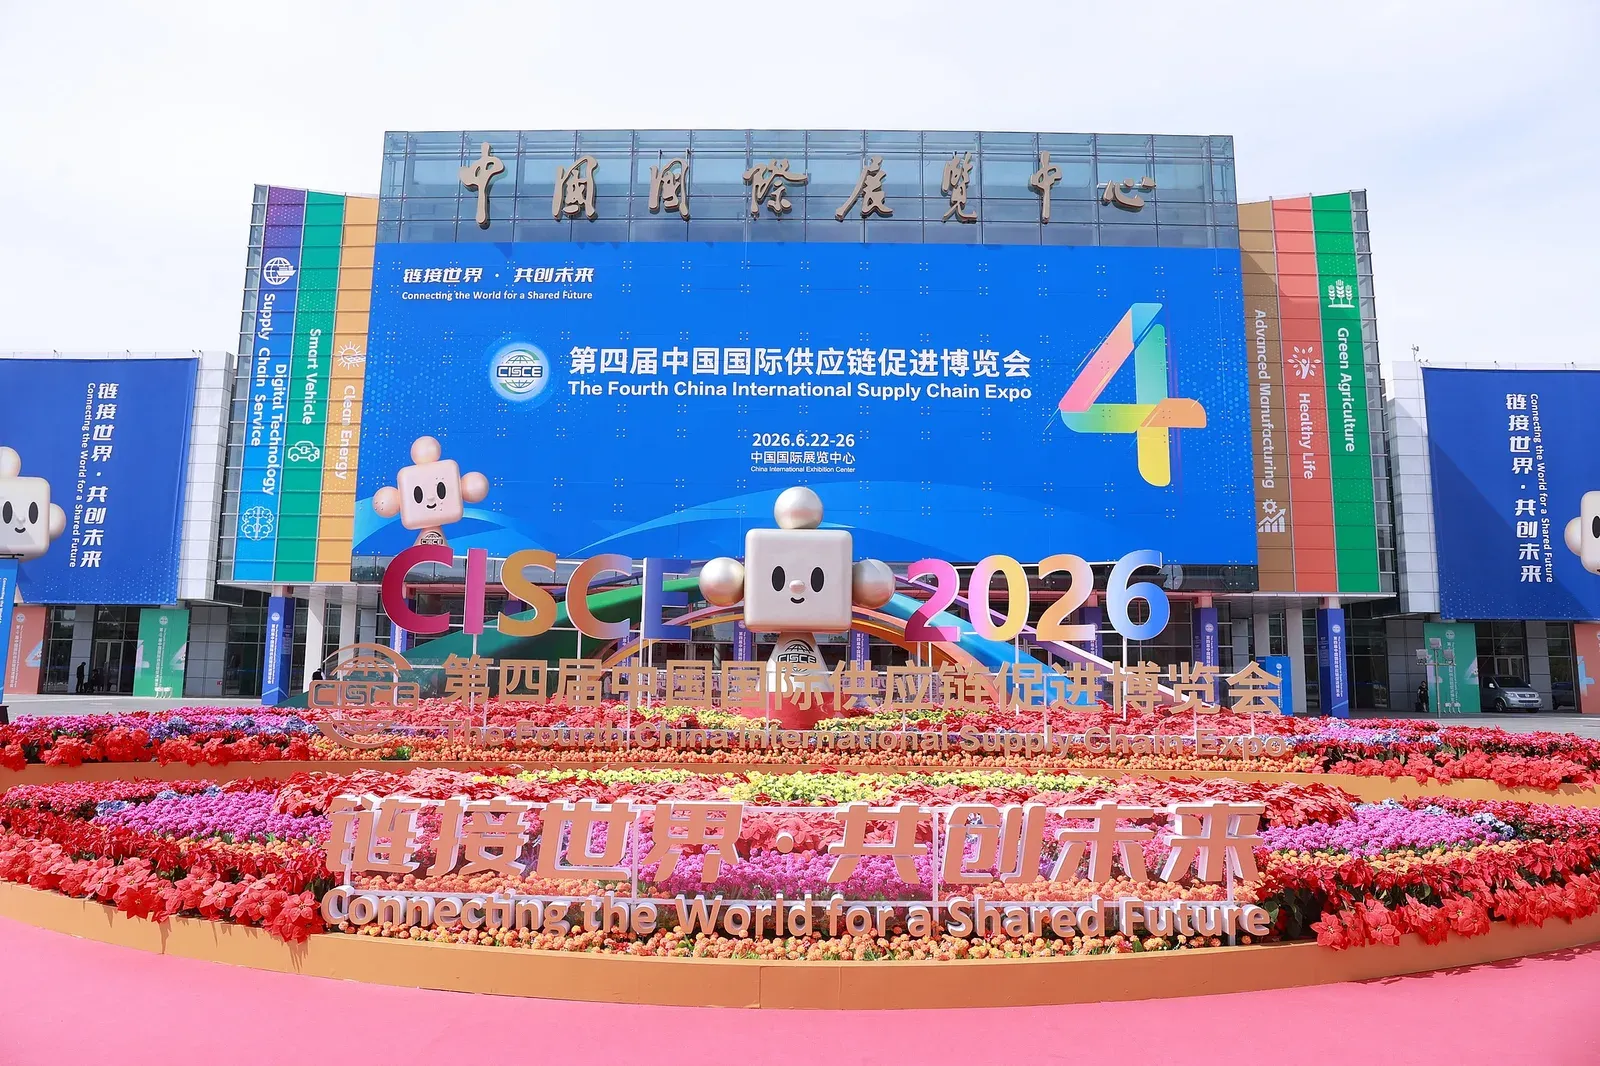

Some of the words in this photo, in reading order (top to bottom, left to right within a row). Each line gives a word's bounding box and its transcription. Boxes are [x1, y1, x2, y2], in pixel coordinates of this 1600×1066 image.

[402, 291, 452, 301] Connecting
[455, 291, 470, 300] the
[473, 291, 501, 300] World
[503, 291, 518, 300] for
[528, 291, 560, 300] Shared
[563, 291, 593, 300] Future
[258, 293, 276, 340] Supply
[307, 328, 321, 369] Smart
[569, 346, 1032, 378] 第四届中国国际供应链促进博览会
[1254, 309, 1271, 380] Advanced
[1337, 327, 1350, 369] Green
[256, 347, 271, 387] Chain
[271, 364, 287, 410] Digital
[498, 366, 542, 377] CISCE
[81, 382, 96, 431] Connecting
[302, 373, 318, 425] Vehicle
[341, 385, 356, 426] Clean
[568, 381, 603, 396] The
[608, 381, 668, 396] Fourth
[674, 381, 727, 397] China
[733, 381, 851, 397] International
[857, 383, 922, 401] Supply
[926, 383, 980, 399] Chain
[985, 384, 1032, 402] Expo
[251, 394, 266, 446] Service
[1298, 393, 1313, 449] Healthy
[1339, 373, 1356, 452] Agriculture
[1530, 393, 1542, 443] Connecting
[81, 433, 91, 448] the
[262, 414, 283, 495] Technology
[335, 430, 352, 479] Energy
[752, 433, 855, 447] 2026.6.22-26
[1259, 382, 1276, 489] Manufacturing
[1535, 445, 1544, 460] the
[78, 450, 89, 477] World
[751, 451, 856, 465] 中国国际展览中心
[1302, 452, 1316, 480] Life
[1537, 462, 1548, 491] World
[76, 479, 86, 494] for
[1539, 492, 1548, 507] for
[72, 504, 83, 535] Shared
[1541, 518, 1552, 550] Shared
[69, 538, 80, 568] Future
[1544, 552, 1553, 583] Future
[381, 545, 693, 641] CISCE
[905, 549, 1171, 642] 2026
[313, 683, 416, 707] CISCE
[442, 652, 1283, 714] 第四届中国国际供应链促进博览会
[442, 719, 504, 747] The
[516, 720, 624, 749] Fourth
[634, 720, 729, 749] China
[740, 724, 948, 751] International
[959, 725, 1074, 757] Supply
[1084, 726, 1184, 756] Chain
[1196, 729, 1288, 760] Expo
[321, 887, 570, 936] Connecting
[581, 892, 657, 934] the
[675, 893, 812, 936] World
[825, 893, 894, 937] for
[908, 908, 932, 938] a
[948, 897, 1104, 938] Shared
[1120, 900, 1270, 938] Future
